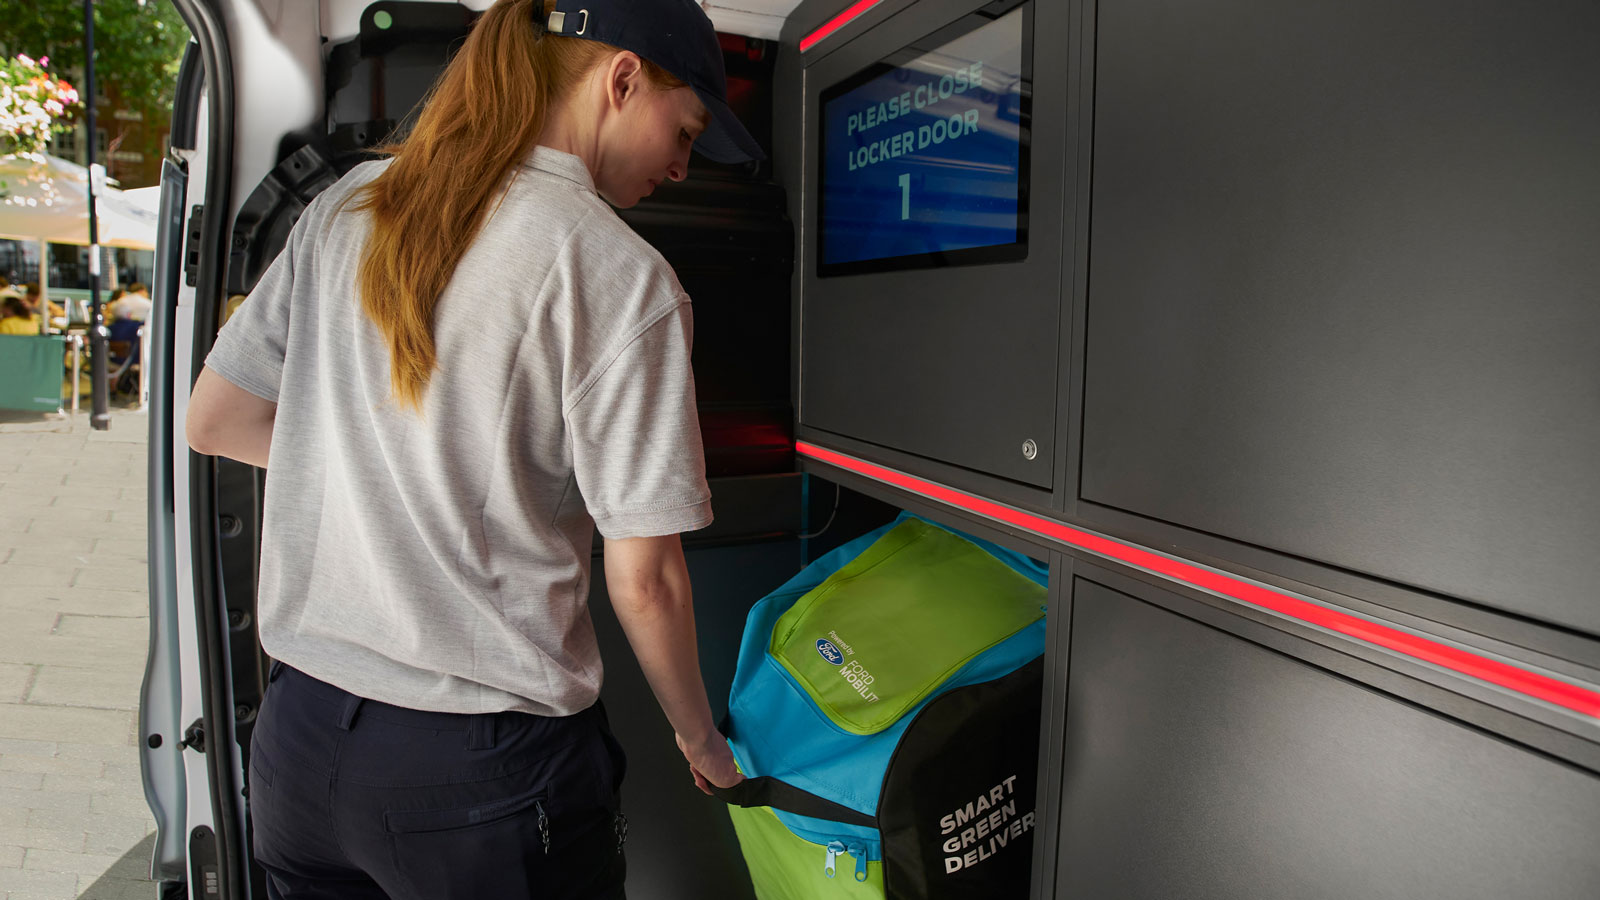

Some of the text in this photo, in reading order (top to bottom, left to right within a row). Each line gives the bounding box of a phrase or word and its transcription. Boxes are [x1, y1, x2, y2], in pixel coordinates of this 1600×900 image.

[847, 61, 983, 136] PLEASE CLOSE
[848, 109, 979, 171] LOCKER DOOR
[898, 173, 911, 220] 1
[818, 642, 840, 662] Ford
[828, 630, 855, 656] Powered by
[839, 666, 880, 703] MOBILIT
[847, 660, 875, 685] FORD
[939, 775, 1017, 835] SMART
[943, 799, 1016, 853] GREEN
[944, 808, 1036, 875] DELIVER
